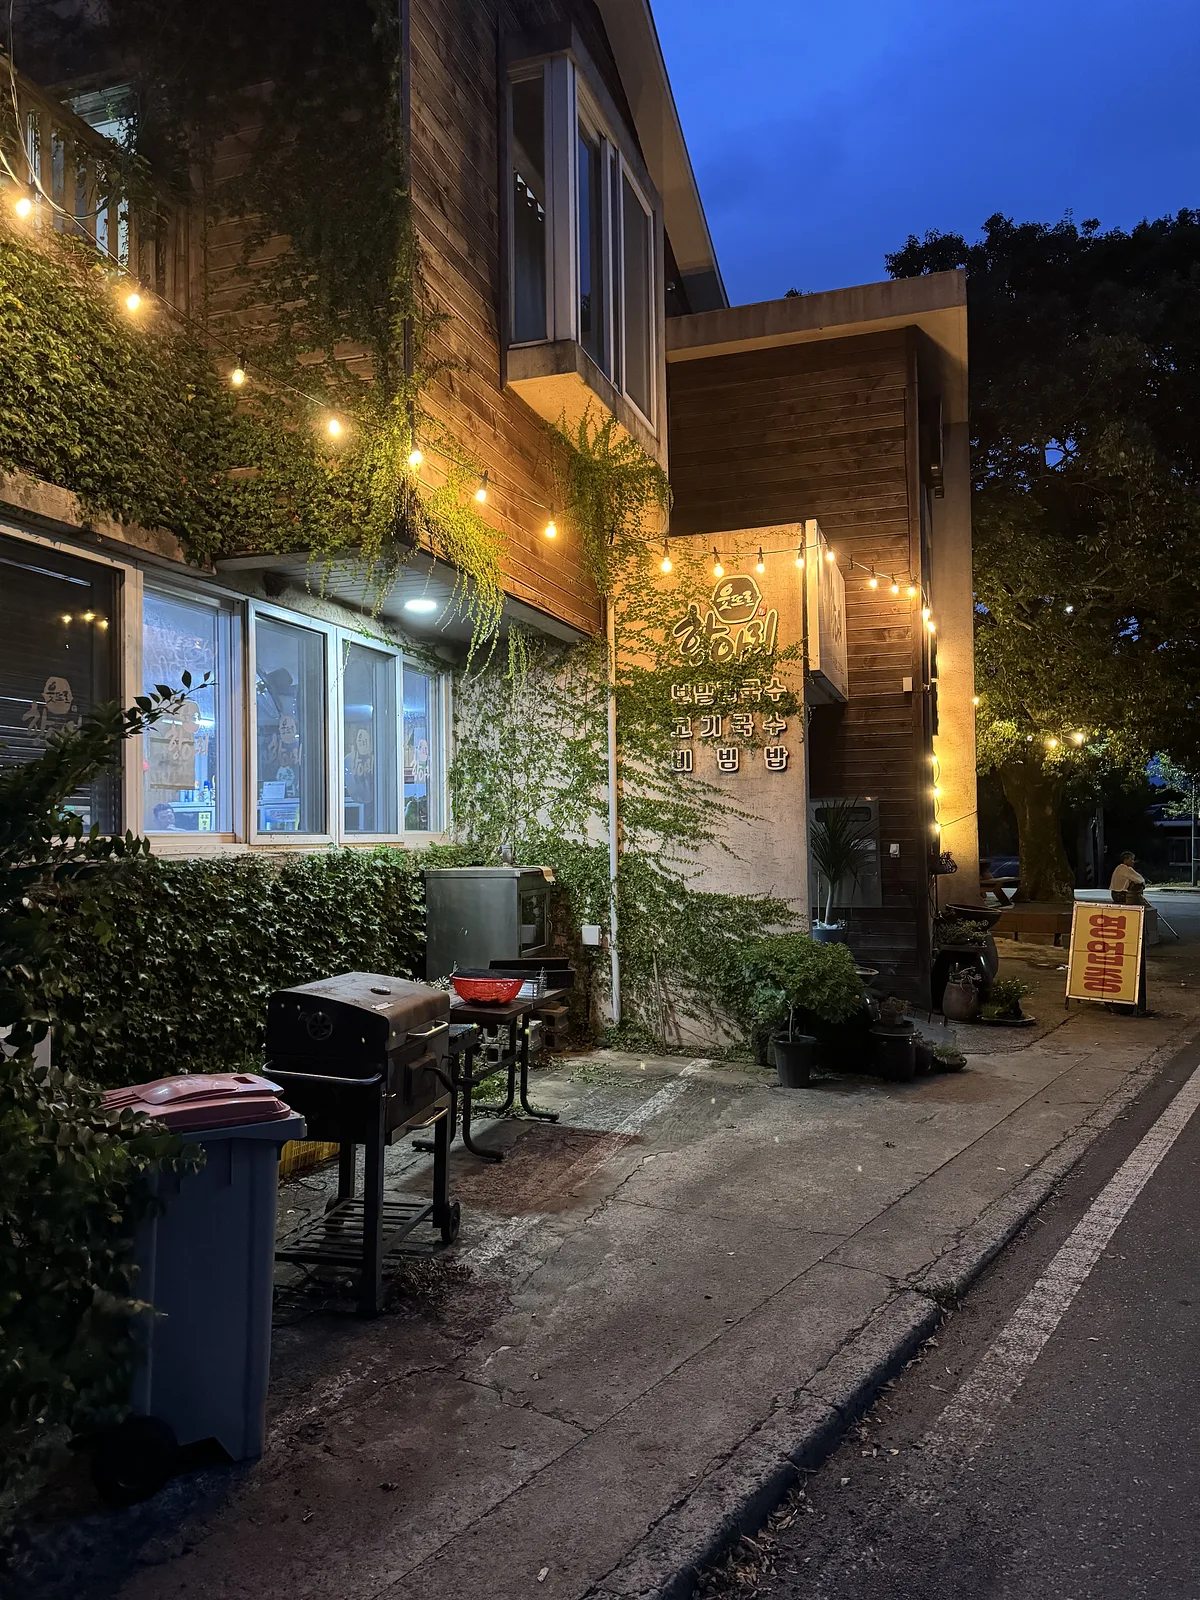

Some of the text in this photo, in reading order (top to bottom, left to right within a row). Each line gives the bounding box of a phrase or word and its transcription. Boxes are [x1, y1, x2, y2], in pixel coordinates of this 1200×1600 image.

[671, 677, 788, 705] 보말국수
[670, 712, 787, 739] 고기국수
[671, 746, 789, 772] 비빔밥
[1083, 914, 1127, 994] 영업중
